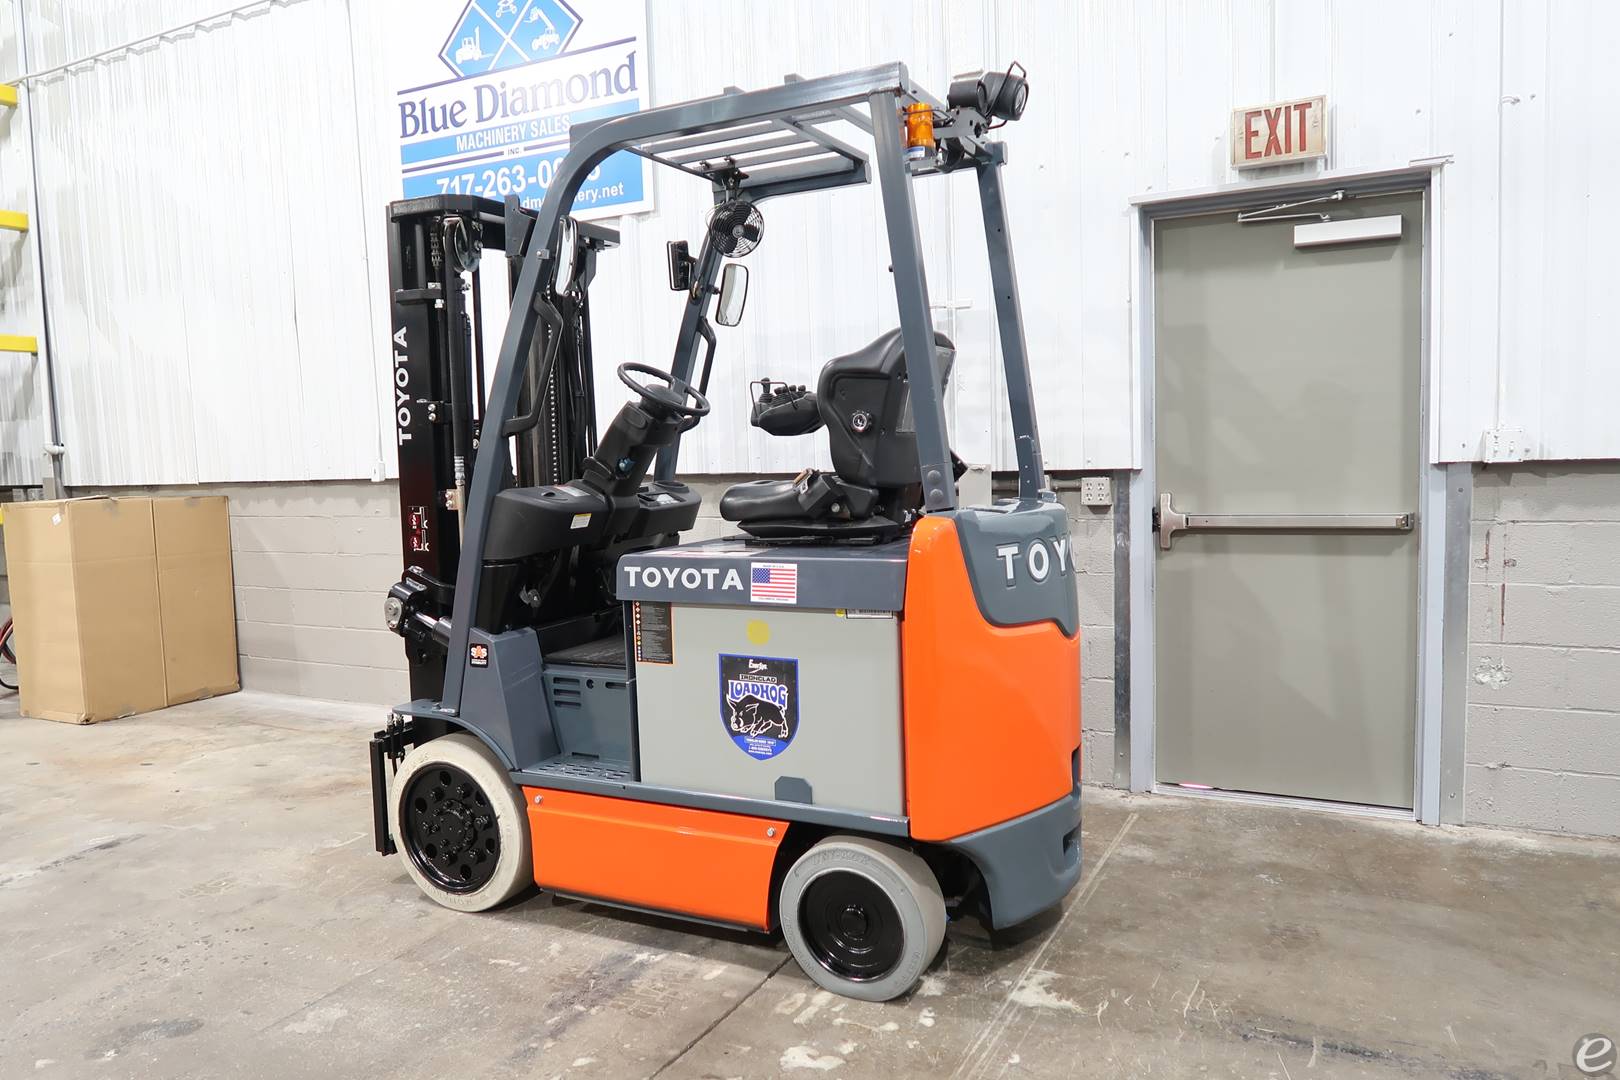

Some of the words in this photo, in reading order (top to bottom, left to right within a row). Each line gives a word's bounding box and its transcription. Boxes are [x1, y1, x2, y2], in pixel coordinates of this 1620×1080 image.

[399, 98, 467, 138] Blue
[474, 51, 638, 123] Diamond
[456, 122, 527, 153] MACHINERY
[530, 116, 570, 139] SALES
[1245, 102, 1312, 160] EXIT
[394, 326, 412, 445] TOYOTA
[624, 566, 744, 591] TOYOTA
[997, 535, 1075, 582] TOY
[729, 681, 788, 708] LOADHOG
[740, 674, 776, 683] IRONCLAD
